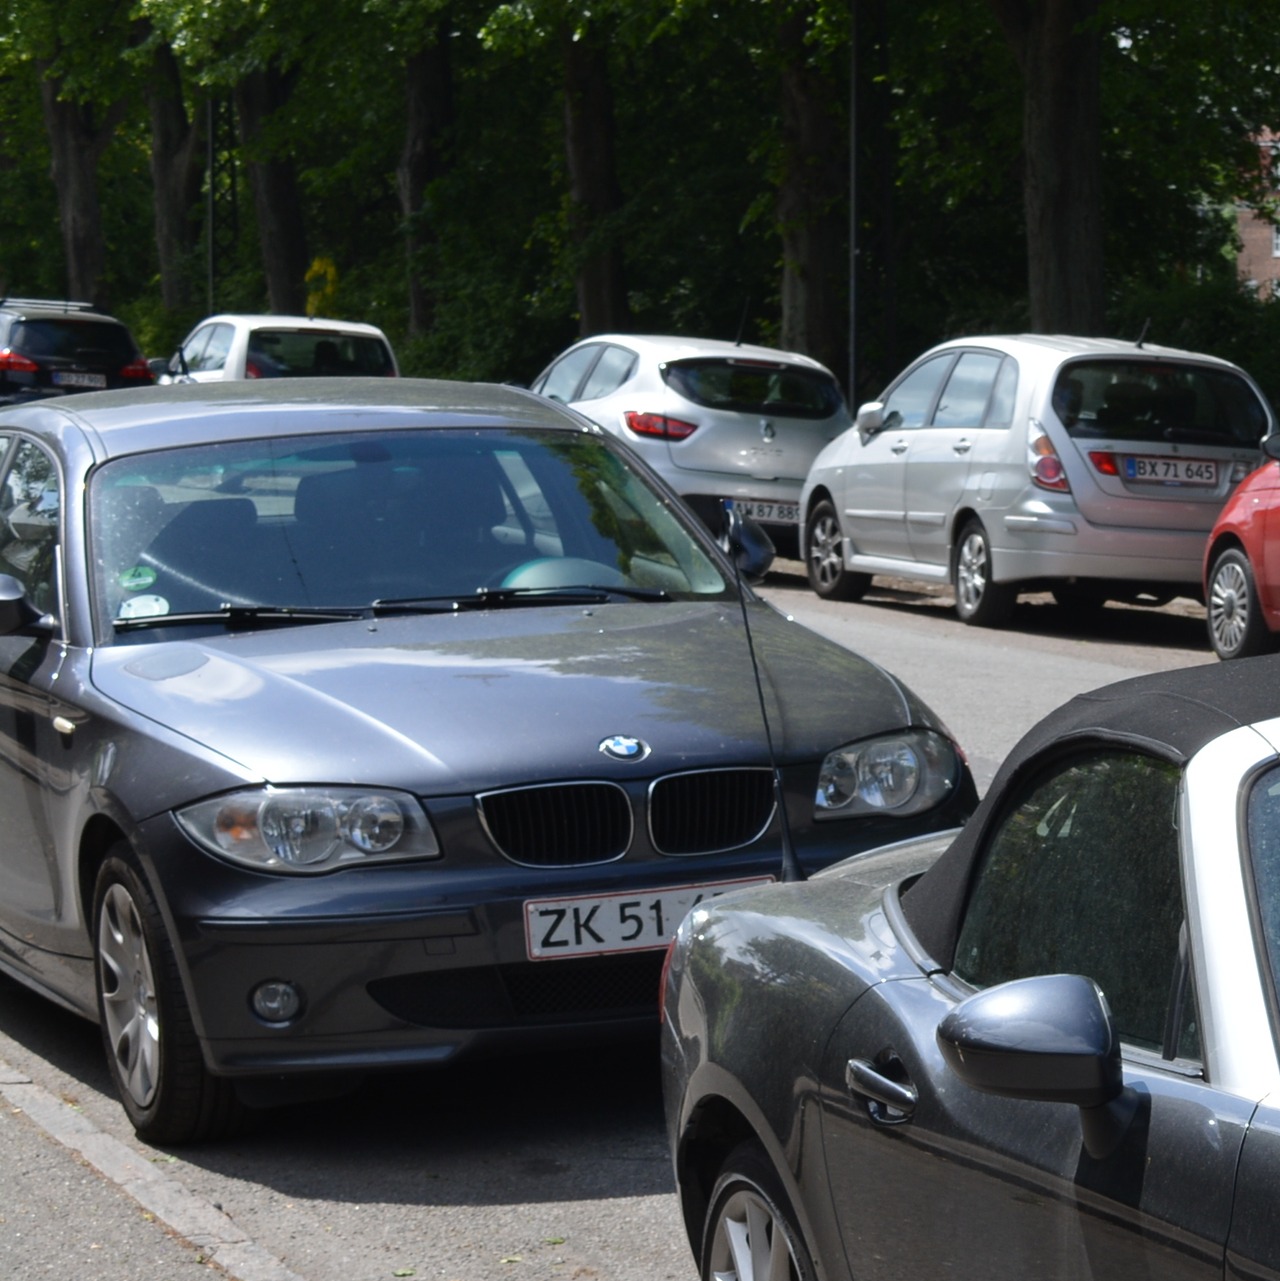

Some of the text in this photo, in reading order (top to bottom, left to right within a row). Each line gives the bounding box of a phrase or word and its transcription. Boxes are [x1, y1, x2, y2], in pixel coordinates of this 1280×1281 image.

[1137, 460, 1214, 480] BX 71 645
[757, 504, 773, 517] 87
[538, 899, 664, 948] ZK 51
